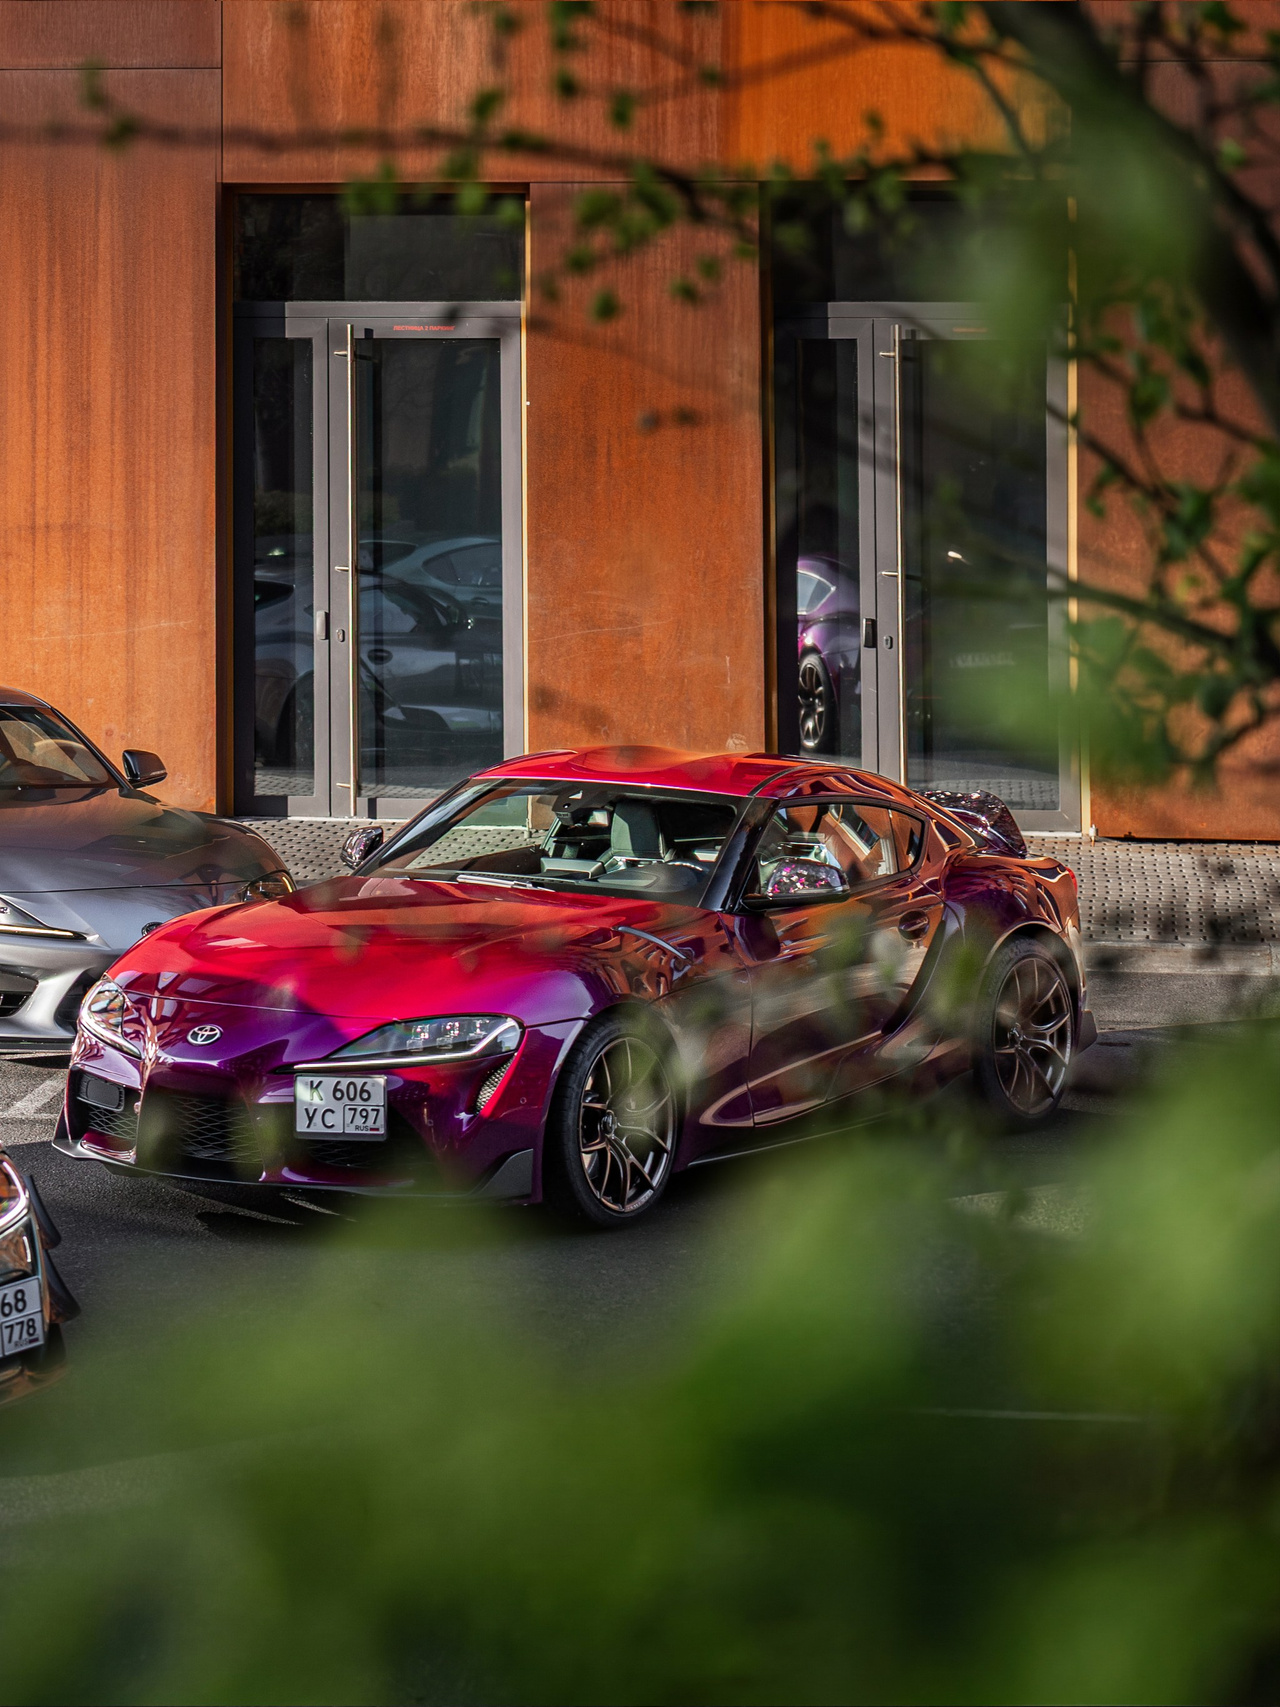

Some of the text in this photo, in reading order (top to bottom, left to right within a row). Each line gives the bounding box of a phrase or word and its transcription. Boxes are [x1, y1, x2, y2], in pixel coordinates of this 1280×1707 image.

[332, 1081, 371, 1102] 606
[348, 1107, 380, 1125] 797
[4, 1318, 36, 1344] 778
